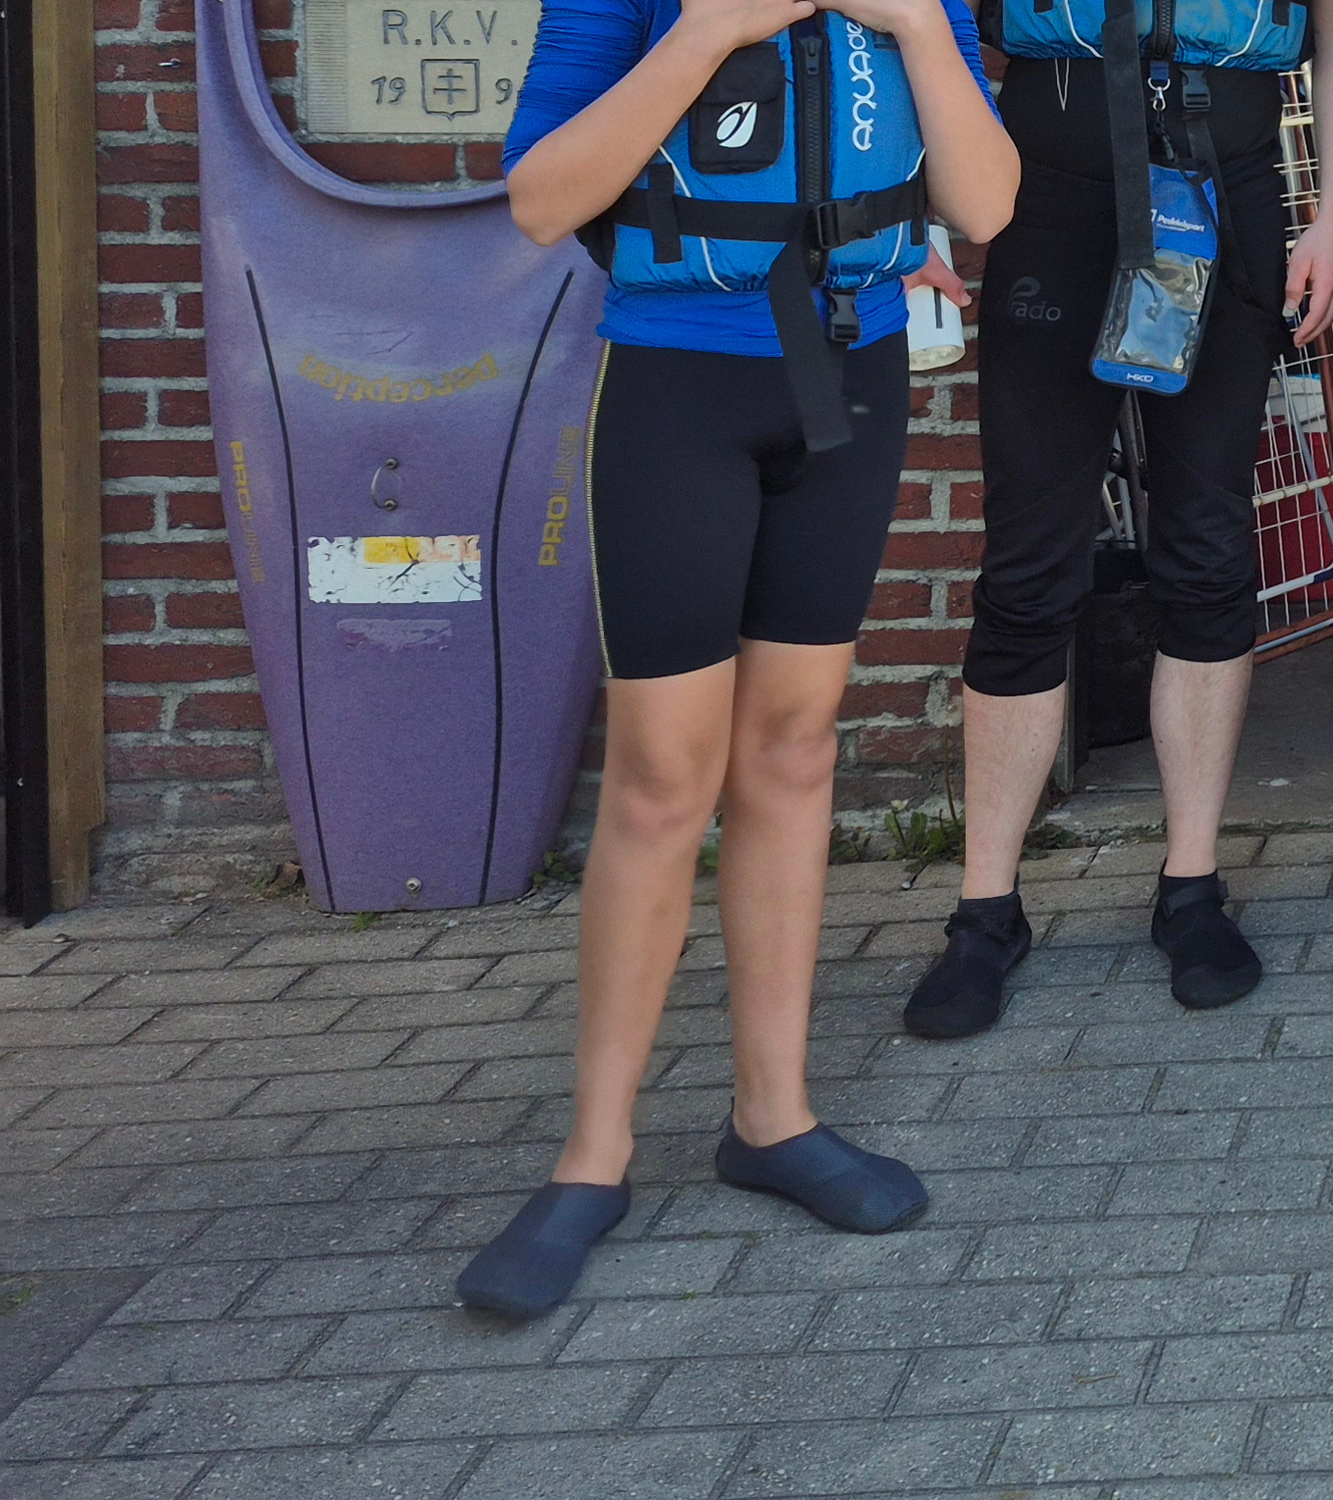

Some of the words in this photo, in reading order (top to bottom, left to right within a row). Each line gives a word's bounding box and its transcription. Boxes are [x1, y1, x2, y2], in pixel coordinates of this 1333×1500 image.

[381, 9, 518, 47] R.K.V.
[371, 75, 407, 105] 19
[495, 77, 516, 105] 9
[299, 352, 499, 403] perception
[538, 425, 583, 567] PROLINE
